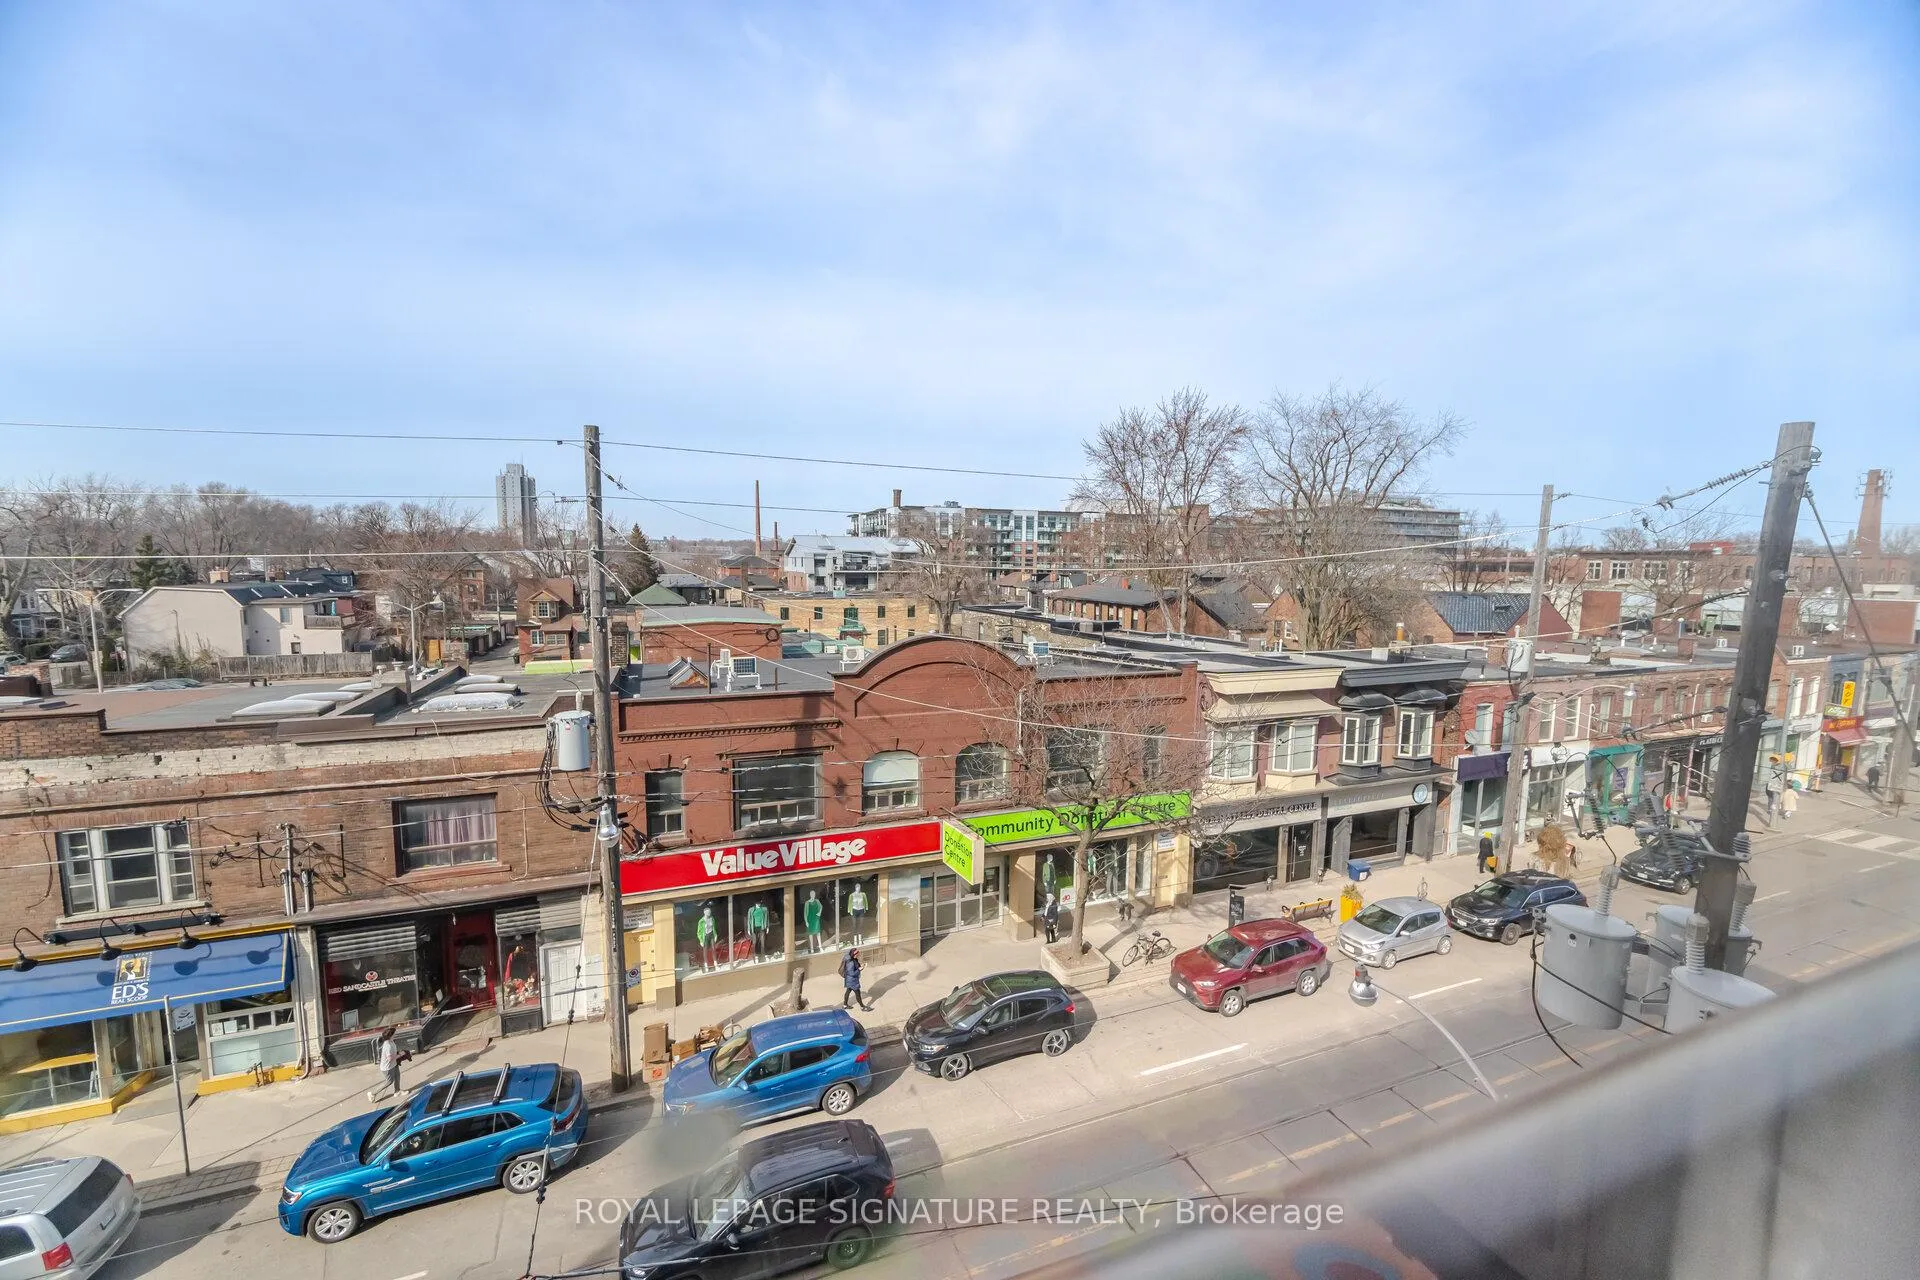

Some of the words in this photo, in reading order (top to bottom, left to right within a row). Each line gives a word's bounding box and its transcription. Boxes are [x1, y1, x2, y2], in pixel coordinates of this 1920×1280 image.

[1288, 801, 1318, 814] CENTRE
[976, 817, 1053, 836] ommunity
[944, 830, 972, 858] Donation
[701, 847, 779, 877] Value
[778, 838, 867, 865] Village
[944, 844, 966, 868] Centre
[111, 982, 149, 1000] ED'S
[343, 979, 386, 993] SANDCASTLE
[386, 974, 416, 985] THEATRE
